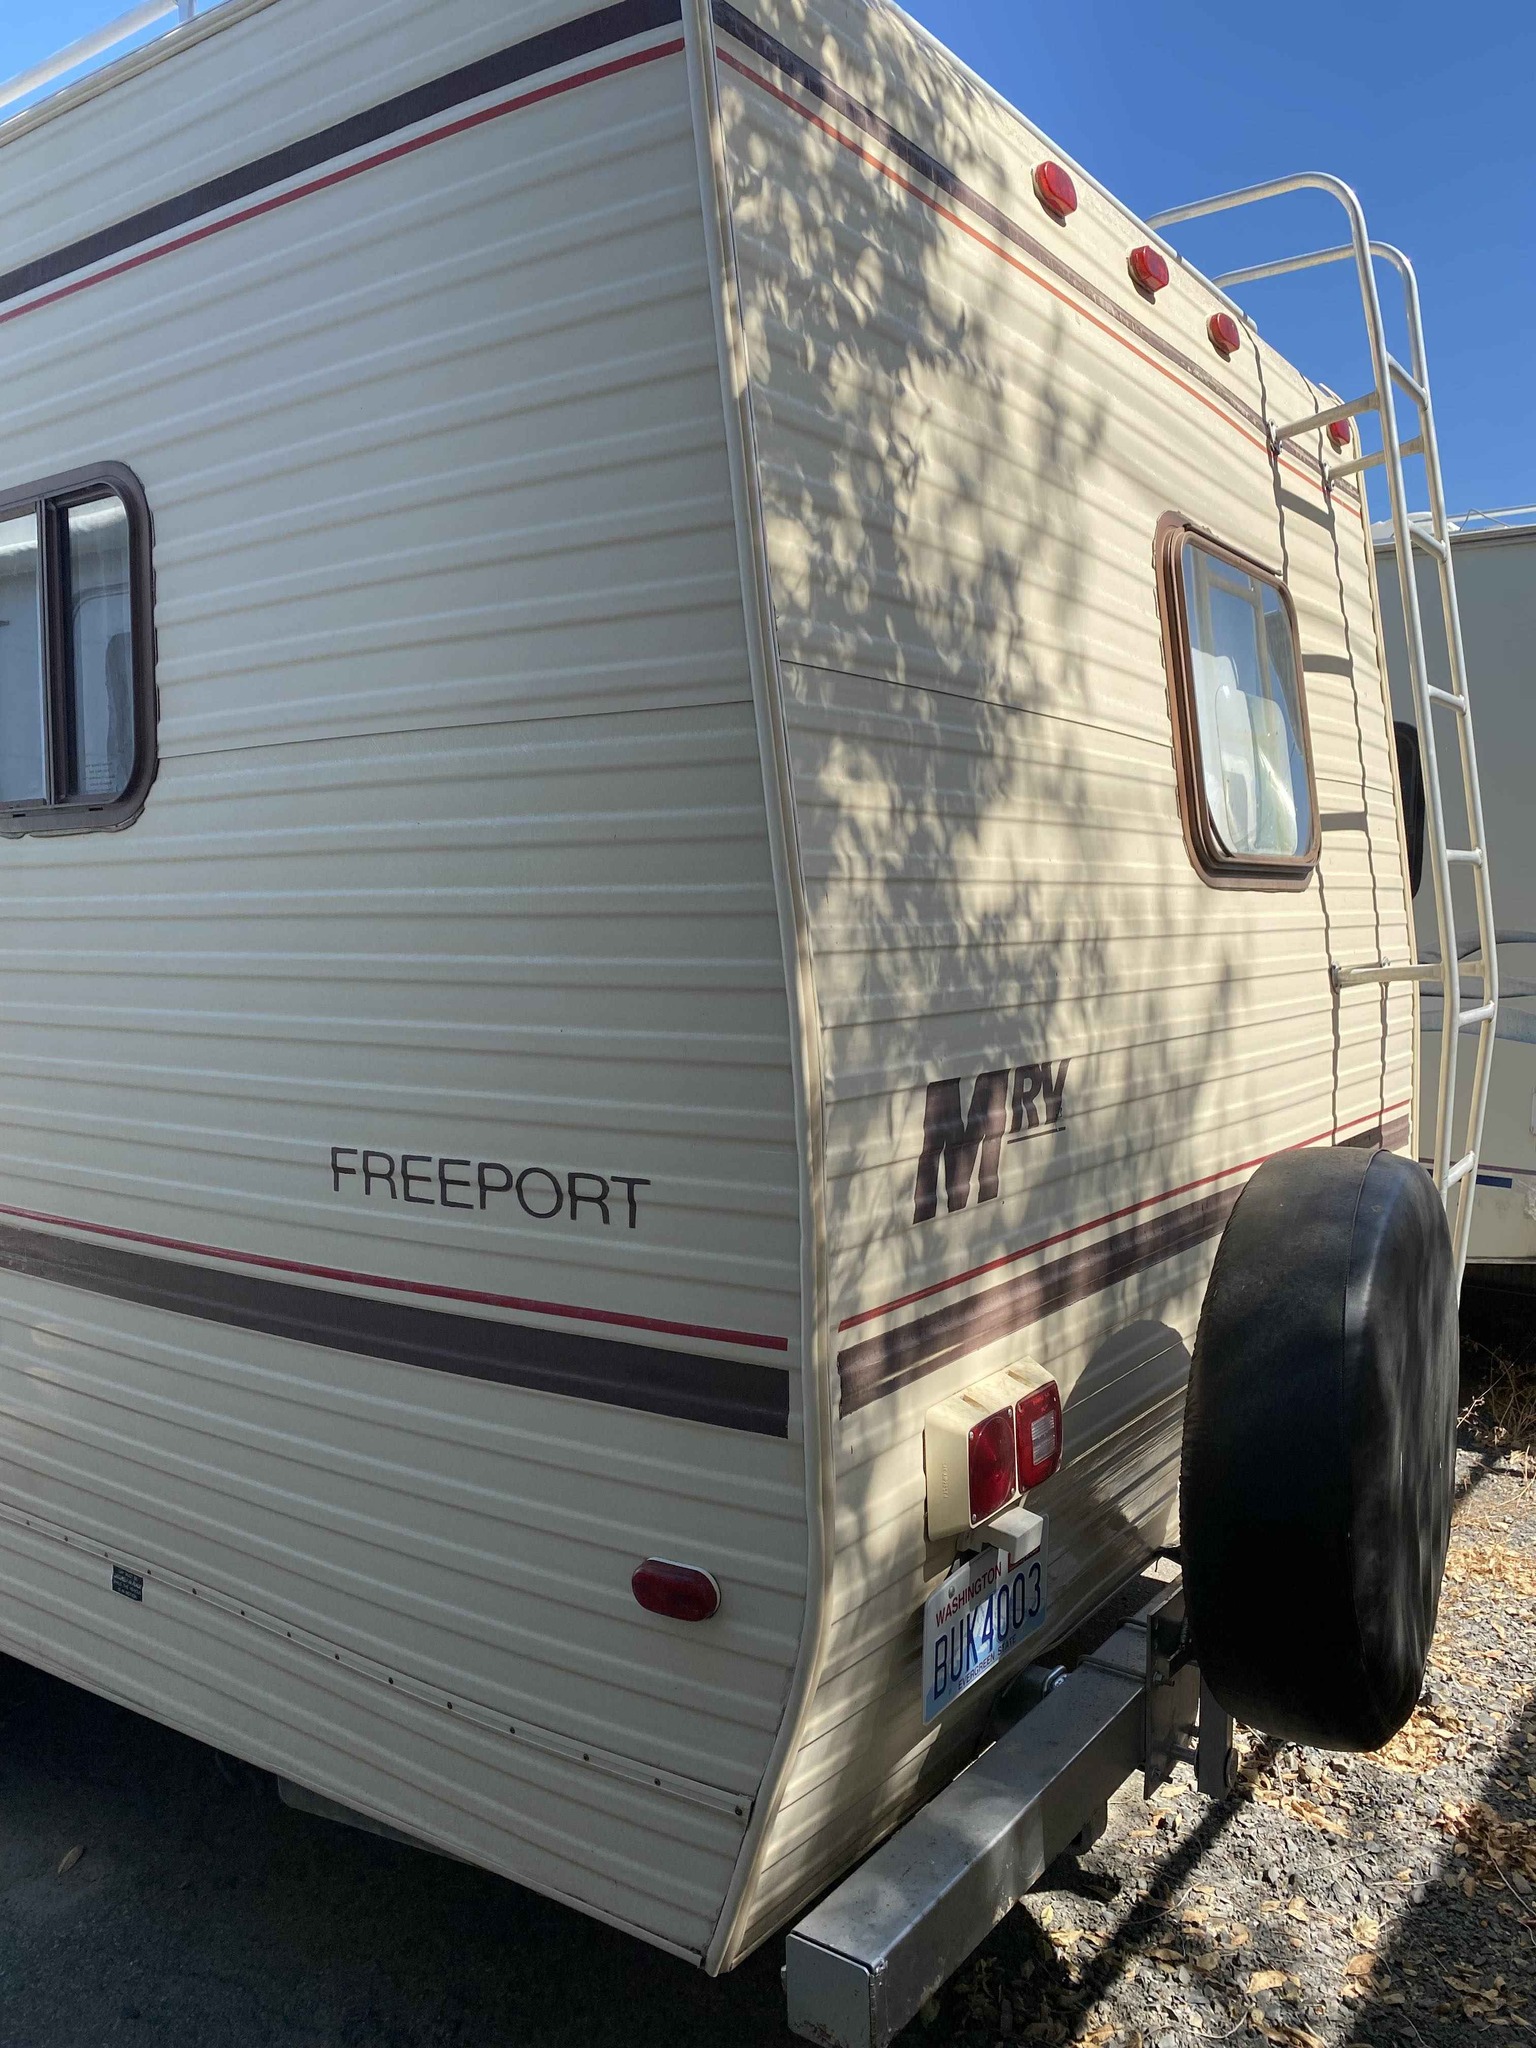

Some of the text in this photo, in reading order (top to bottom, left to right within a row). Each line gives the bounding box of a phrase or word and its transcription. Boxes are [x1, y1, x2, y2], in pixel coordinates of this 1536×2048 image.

[331, 1147, 651, 1229] FREEPORT
[933, 1562, 1041, 1701] BUK4003
[935, 1562, 1002, 1628] WASHINGTON
[958, 1634, 1017, 1691] EVERGREEN STATE
